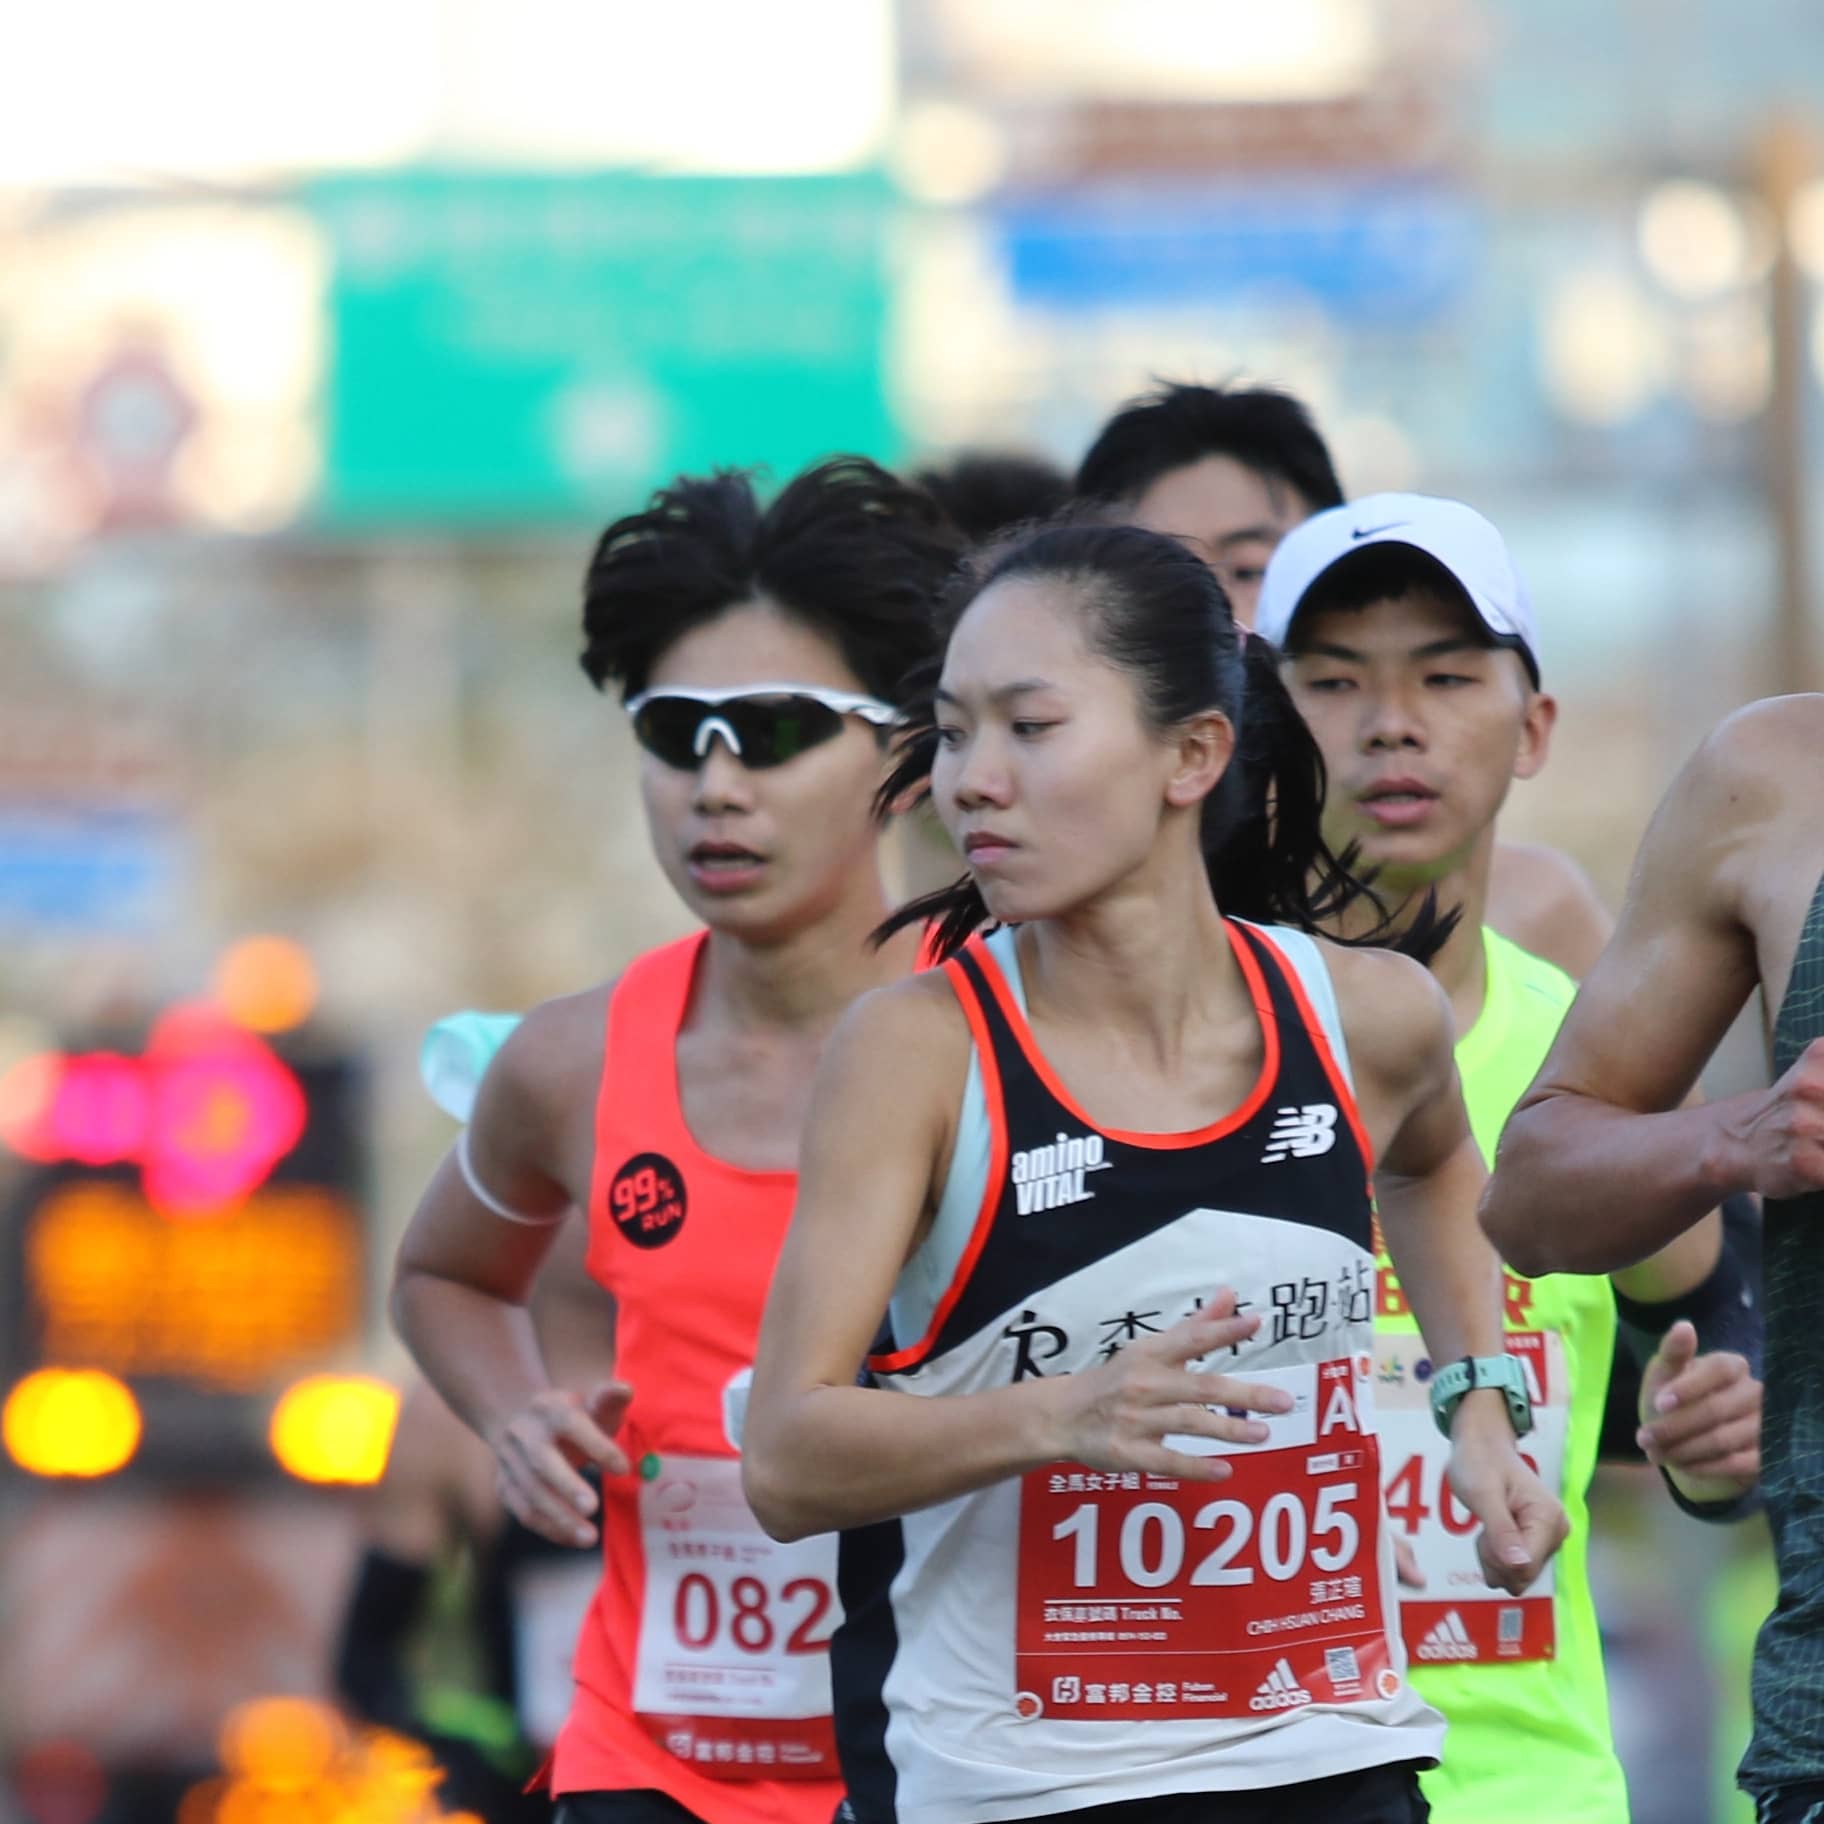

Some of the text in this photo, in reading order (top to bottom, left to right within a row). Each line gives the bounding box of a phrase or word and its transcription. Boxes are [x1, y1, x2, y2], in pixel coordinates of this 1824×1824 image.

[1011, 1132, 1106, 1184] amino
[1014, 1169, 1096, 1216] VITAL
[641, 1202, 683, 1232] RUN
[1319, 1385, 1358, 1436] A
[1053, 1483, 1360, 1588] 10205
[1416, 1643, 1479, 1660] adidas
[1249, 1689, 1313, 1711] adidas
